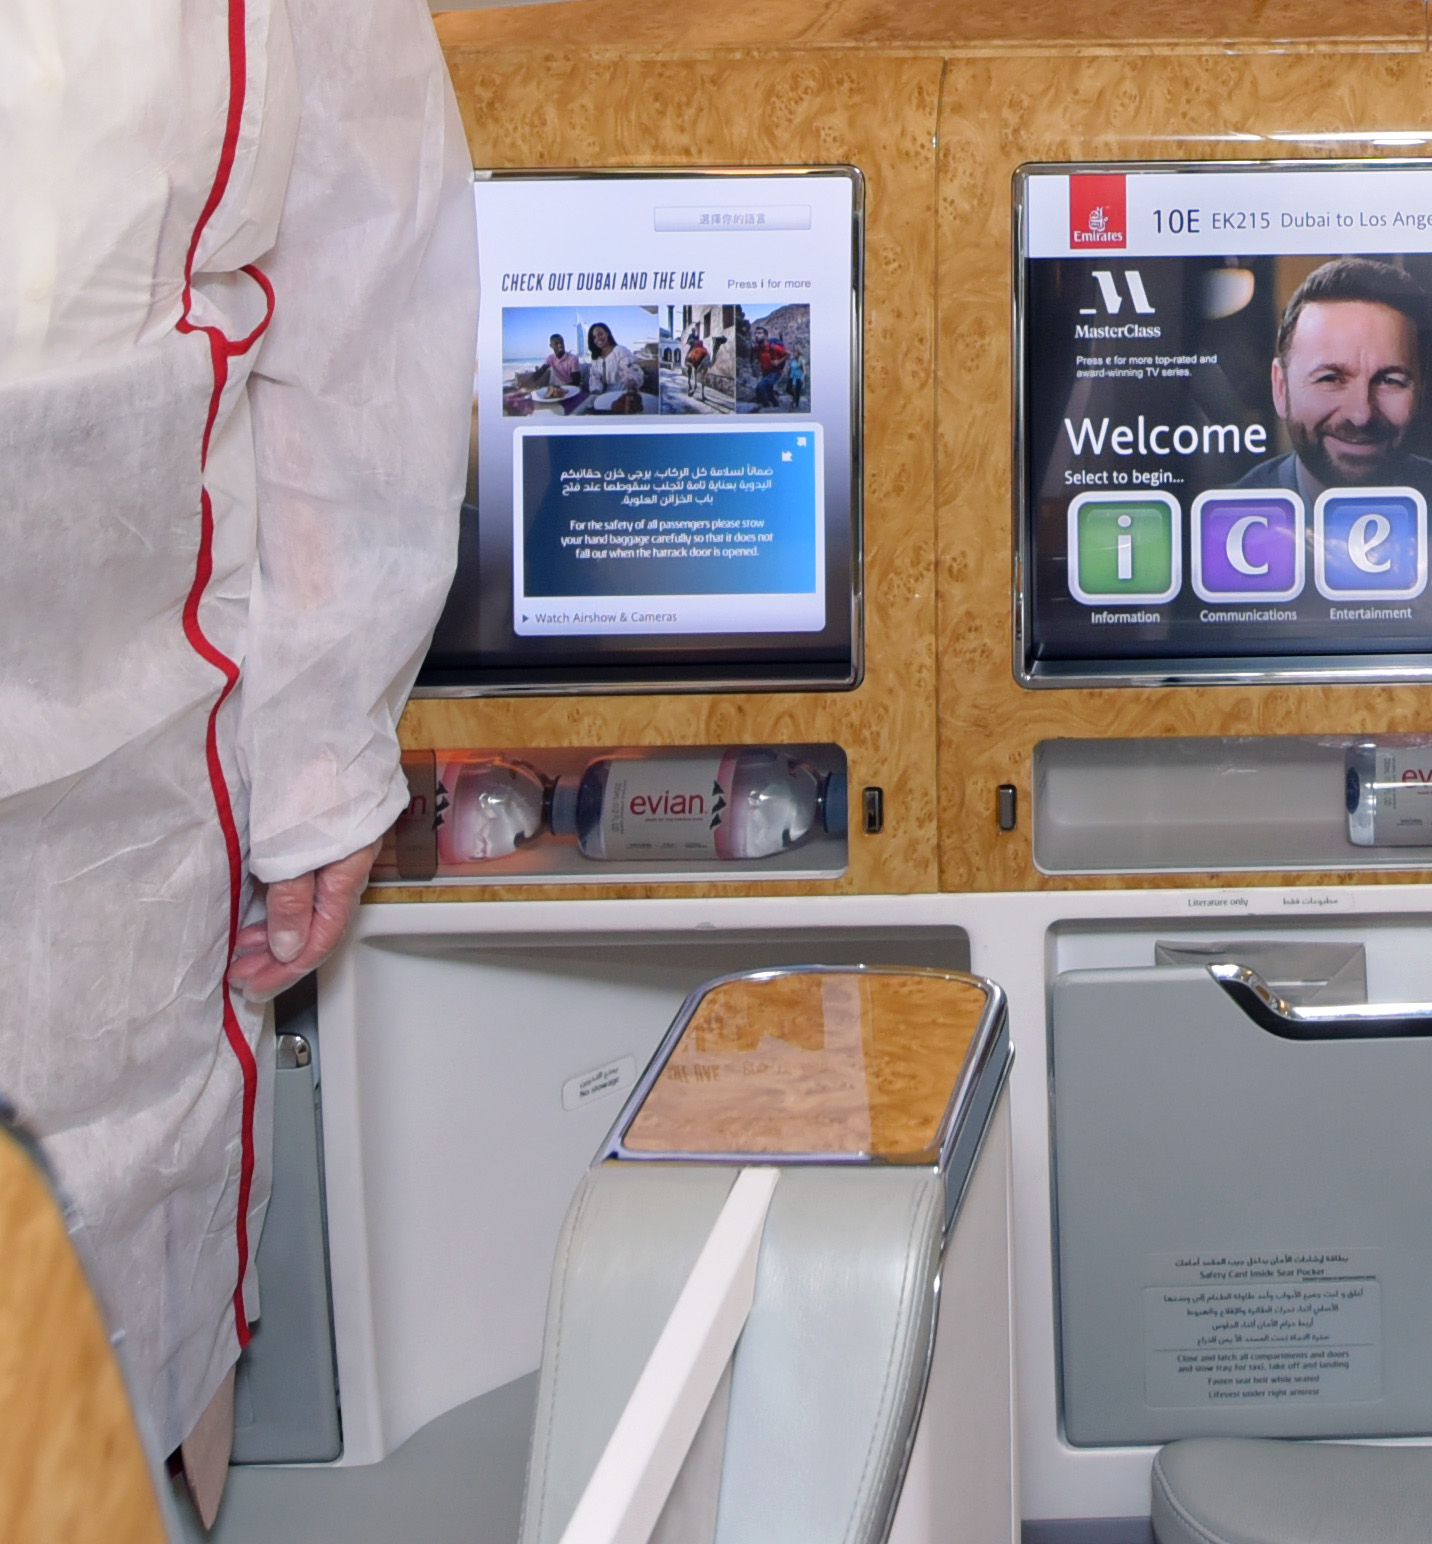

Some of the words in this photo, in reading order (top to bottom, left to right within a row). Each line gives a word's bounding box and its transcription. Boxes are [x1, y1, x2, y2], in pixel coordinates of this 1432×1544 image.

[1153, 208, 1200, 234] 10E
[1212, 211, 1270, 229] EK215
[1281, 211, 1329, 227] Dubai
[1336, 213, 1353, 226] to
[1360, 212, 1386, 226] Los
[1073, 230, 1123, 242] Emirates
[501, 273, 544, 291] CHECK
[548, 272, 572, 290] OUT
[576, 272, 616, 290] DUBAI
[620, 272, 647, 289] AND
[652, 271, 675, 289] THE
[679, 271, 704, 289] UAE
[727, 279, 757, 288] Press
[767, 278, 781, 288] for
[784, 280, 811, 288] more
[1074, 324, 1160, 338] MasterClass
[1076, 356, 1102, 366] Press
[1114, 355, 1126, 365] for
[1129, 357, 1152, 365] more
[1155, 354, 1196, 367] top-rated
[1200, 354, 1216, 364] and
[1076, 369, 1143, 380] award-winning
[1145, 368, 1159, 377] TV
[1064, 416, 1267, 455] Welcome
[1064, 470, 1108, 484] Select
[1112, 470, 1128, 483] to
[1118, 515, 1131, 578] i
[1226, 516, 1268, 575] c
[1347, 514, 1391, 573] e
[535, 613, 569, 624] Watch
[573, 612, 616, 623] Airshow
[631, 611, 676, 622] Cameras
[1091, 610, 1160, 623] Information
[1200, 608, 1296, 622] Communications
[1330, 606, 1412, 619] Entertainment
[629, 790, 704, 816] evian
[1188, 898, 1228, 907] Literature
[1229, 897, 1249, 907] only
